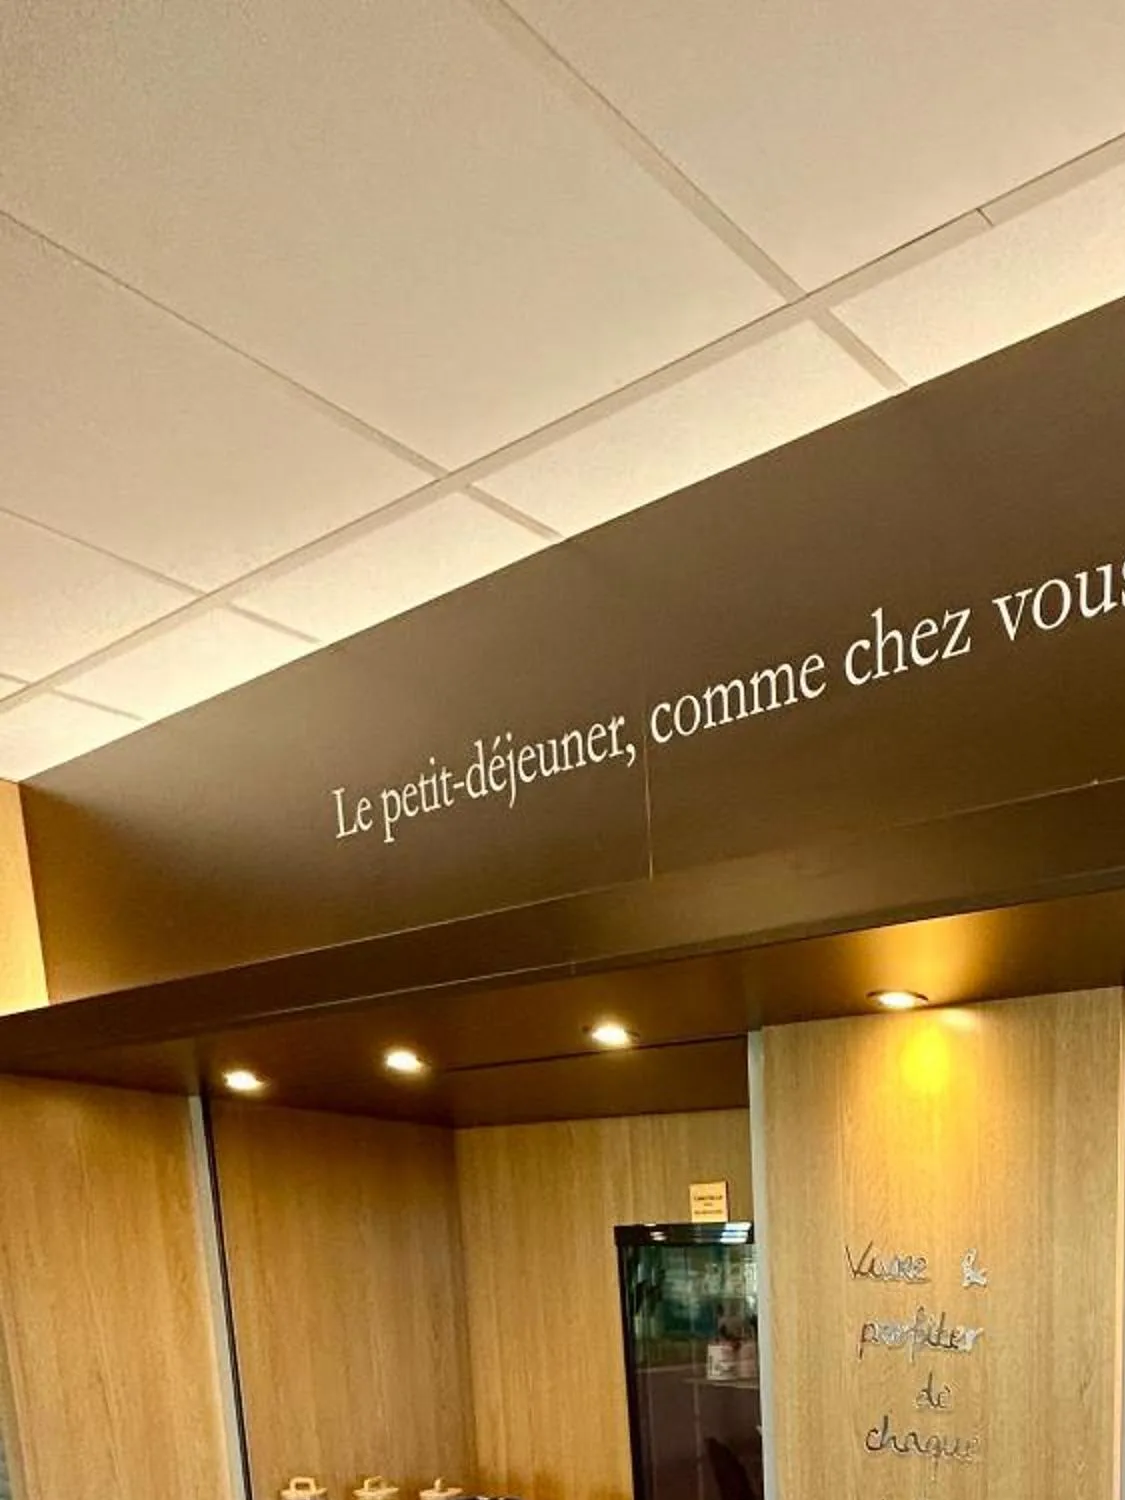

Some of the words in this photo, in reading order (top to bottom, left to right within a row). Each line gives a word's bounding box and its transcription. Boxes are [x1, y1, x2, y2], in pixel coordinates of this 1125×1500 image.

[332, 786, 374, 839] Le
[380, 714, 637, 844] petit-déjeuner,
[649, 653, 827, 746] comme
[843, 608, 973, 686] chez
[865, 1414, 980, 1480] chaque
